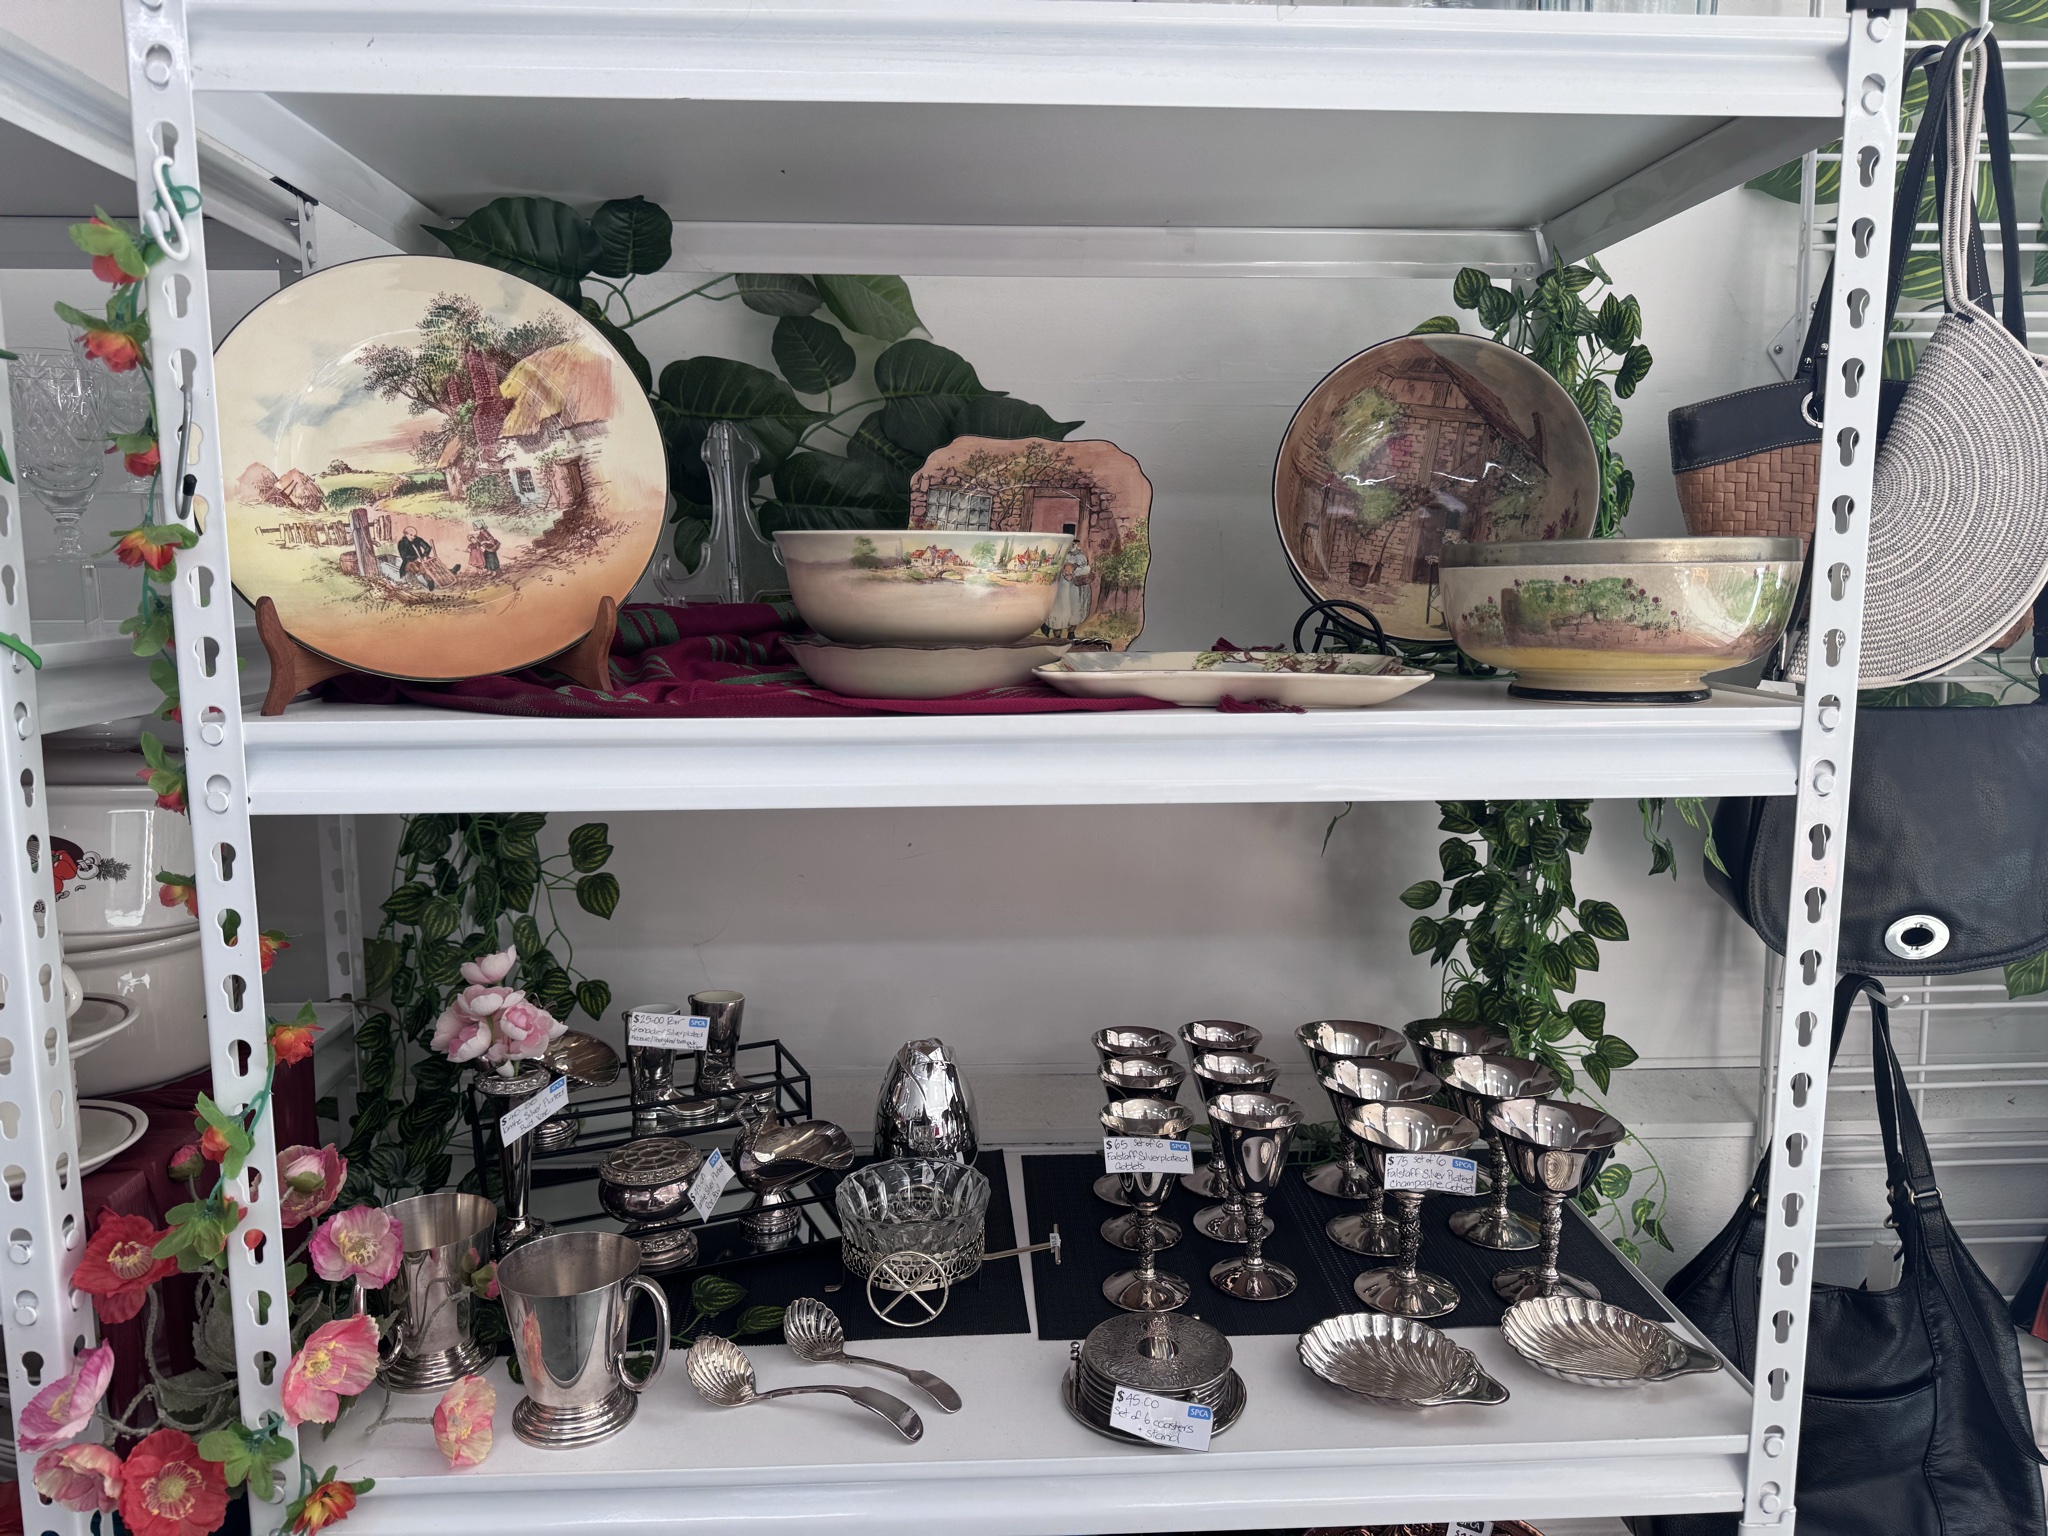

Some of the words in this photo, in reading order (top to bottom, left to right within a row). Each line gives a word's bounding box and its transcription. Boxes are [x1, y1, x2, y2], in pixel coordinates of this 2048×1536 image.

[1146, 1139, 1154, 1148] of
[1156, 1140, 1164, 1148] 6
[1388, 1156, 1408, 1167] $75
[1426, 1154, 1436, 1164] of
[1436, 1156, 1446, 1166] 6
[1454, 1160, 1472, 1170] SPCA
[1422, 1169, 1446, 1180] Silver
[1447, 1170, 1474, 1184] Plated
[1116, 1390, 1160, 1409] $45.00
[1190, 1408, 1208, 1418] SPCA
[1131, 1411, 1142, 1420] of
[1144, 1412, 1150, 1424] 6
[1153, 1419, 1194, 1434] coasters
